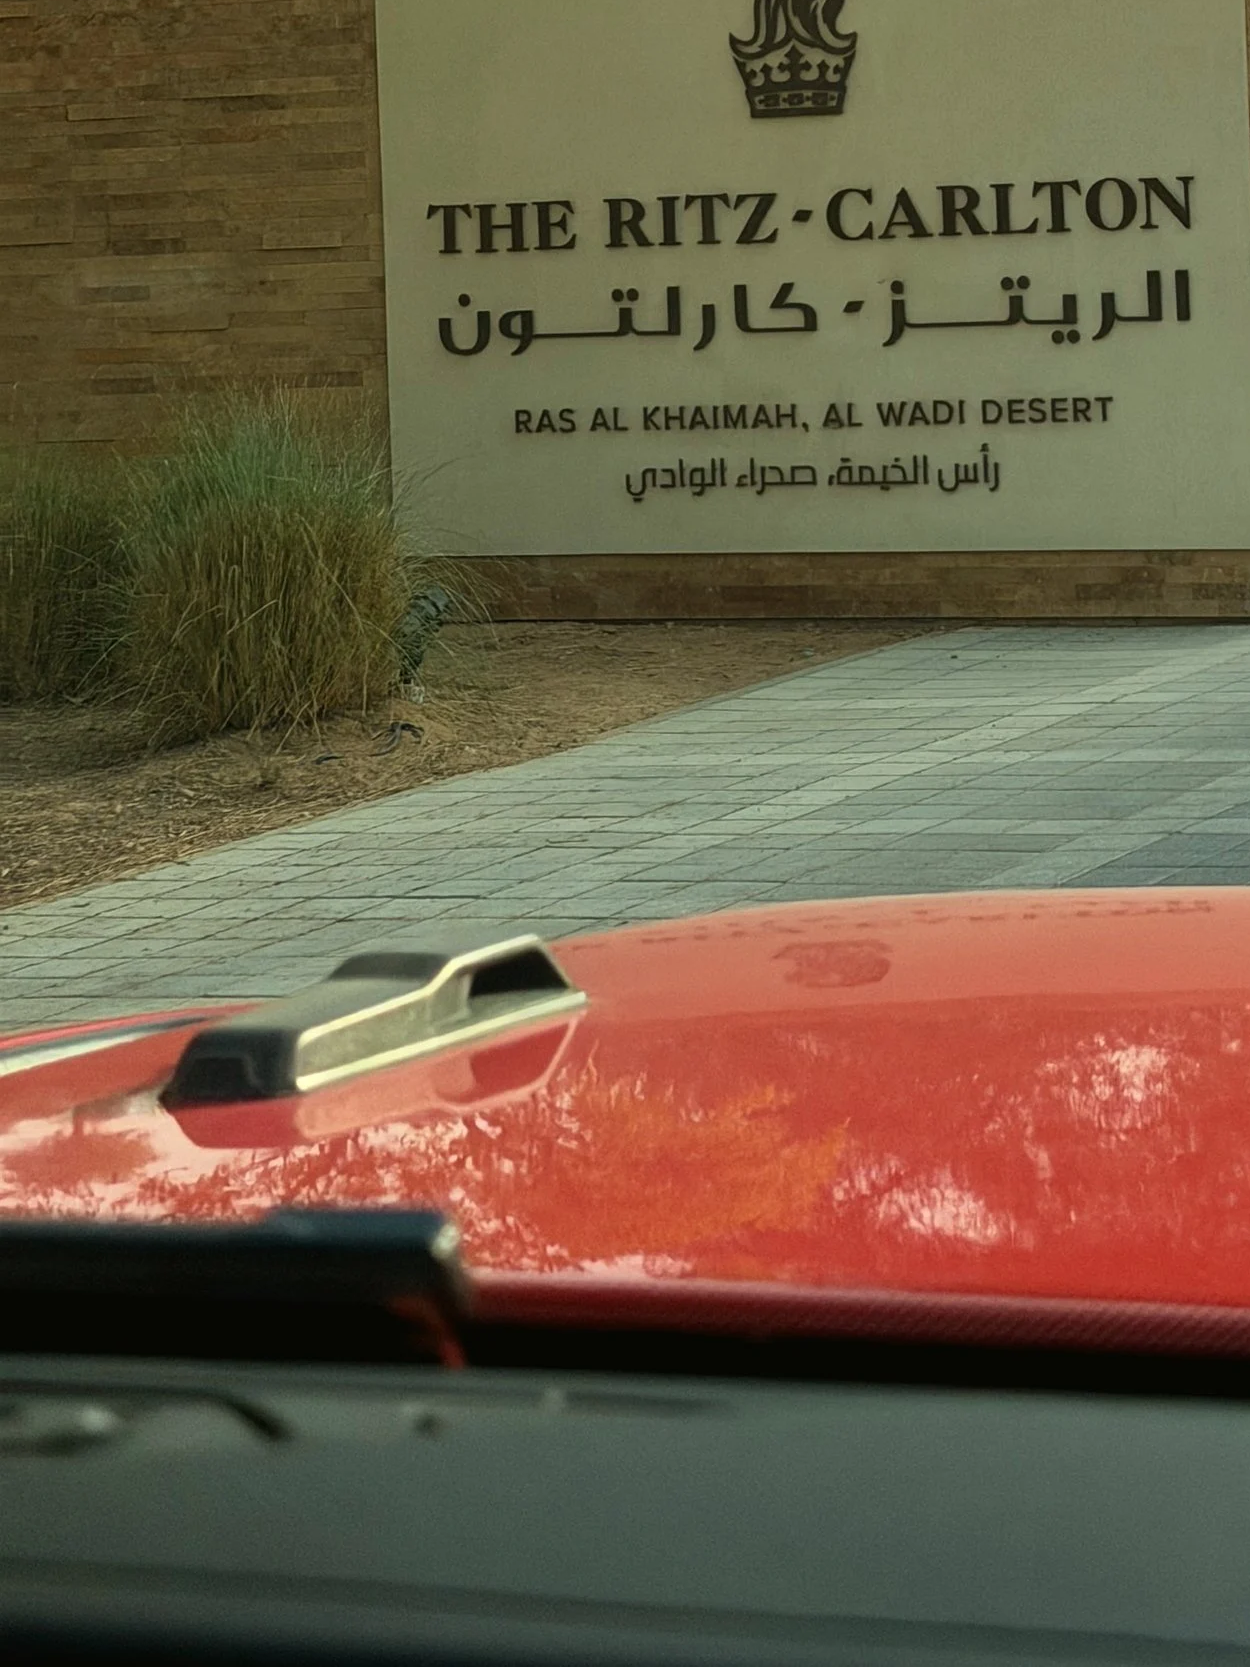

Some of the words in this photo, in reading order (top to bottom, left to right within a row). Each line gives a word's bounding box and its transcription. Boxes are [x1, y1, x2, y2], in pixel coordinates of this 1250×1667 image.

[426, 199, 578, 255] THE
[513, 408, 577, 434] RAS
[589, 407, 629, 432] AL
[642, 403, 810, 433] KHAIMAH,
[822, 402, 863, 428] AL
[876, 399, 966, 427] WADI
[980, 396, 1114, 425] DESERT
[624, 457, 728, 504] الوادي
[735, 457, 818, 496] صحراء
[937, 442, 1001, 493] رأس
